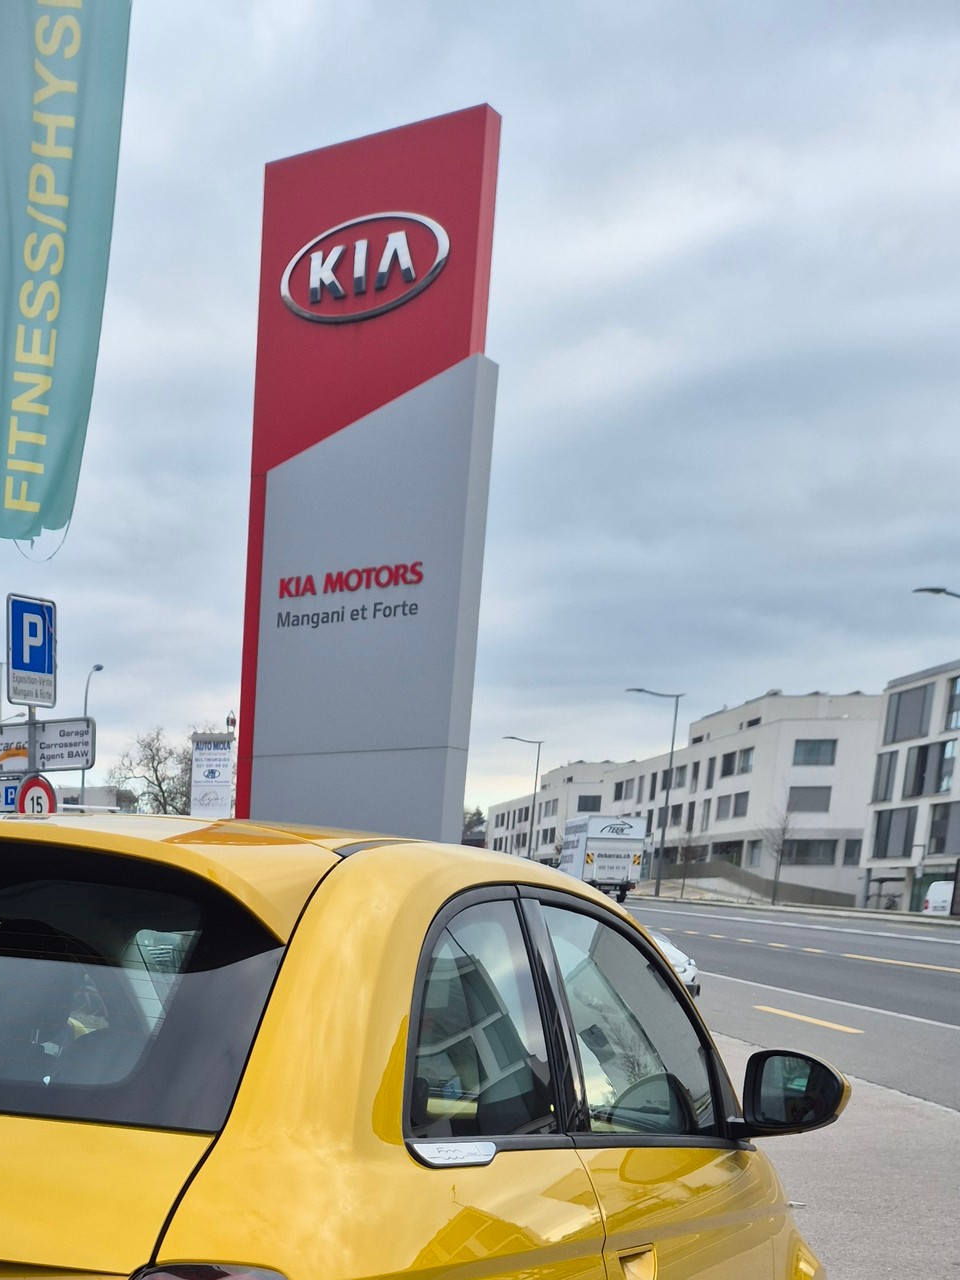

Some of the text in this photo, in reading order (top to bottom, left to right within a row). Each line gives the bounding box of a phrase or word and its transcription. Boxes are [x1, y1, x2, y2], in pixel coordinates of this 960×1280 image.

[309, 230, 417, 305] KIA
[278, 561, 424, 599] KIA MOTORS
[276, 601, 419, 629] Mangani et Forte
[22, 612, 44, 664] P
[59, 729, 90, 738] Garage
[40, 740, 90, 750] Carrosserie
[195, 741, 212, 751] AUTO
[40, 749, 89, 761] Agent BAW
[30, 795, 43, 813] 15
